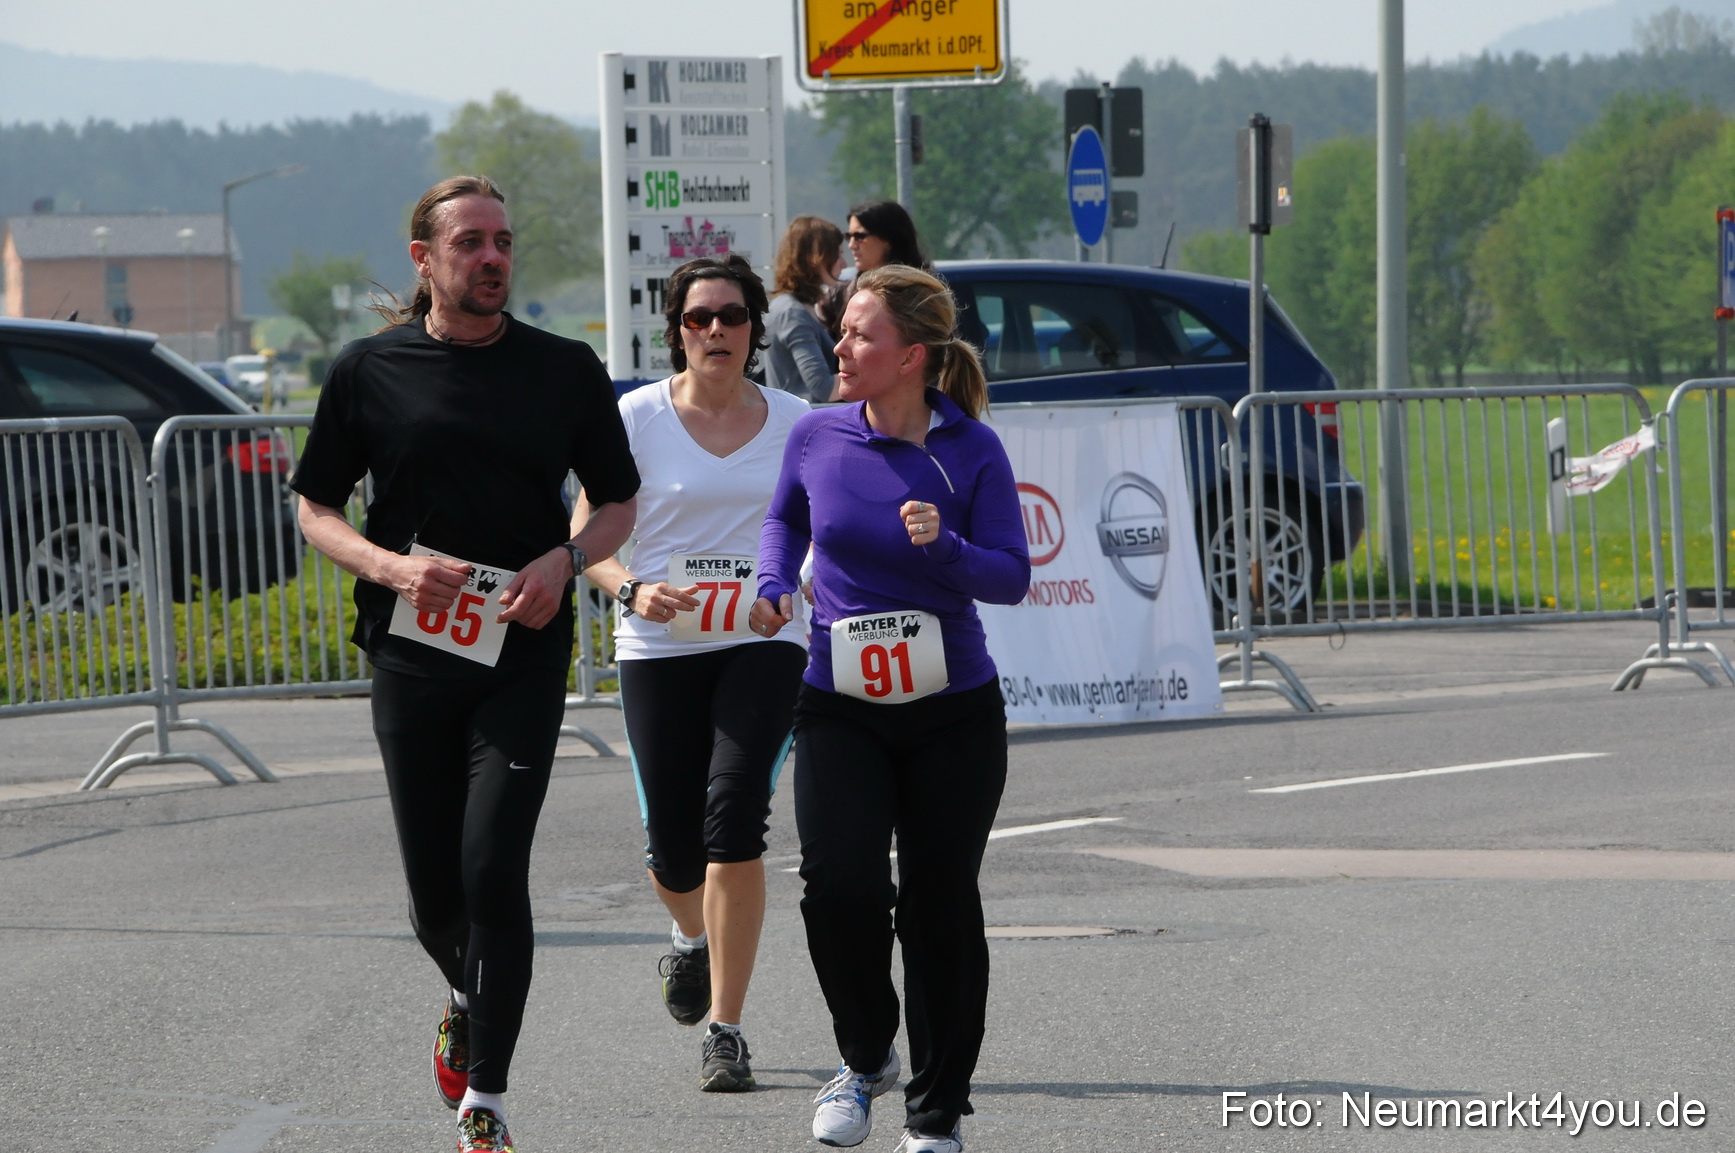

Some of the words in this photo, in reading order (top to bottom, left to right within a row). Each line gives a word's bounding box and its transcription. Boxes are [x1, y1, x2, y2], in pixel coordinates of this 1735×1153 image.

[844, 1, 876, 19] am
[890, 0, 957, 21] Anger
[818, 41, 855, 60] Kreis
[861, 38, 930, 58] Neumarkt
[679, 61, 748, 83] HOLZAMMER
[681, 114, 749, 136] HOLZAMMER
[644, 170, 681, 211] SHB
[682, 175, 750, 203] Holzfachmarkt
[1105, 525, 1167, 548] NISSA
[685, 559, 732, 570] MEYER
[685, 569, 733, 578] WERBUNG
[1027, 578, 1095, 607] MOTORS
[695, 581, 742, 632] 77
[848, 616, 898, 634] MEYER
[848, 628, 900, 643] WERBUNG
[860, 641, 915, 698] 91
